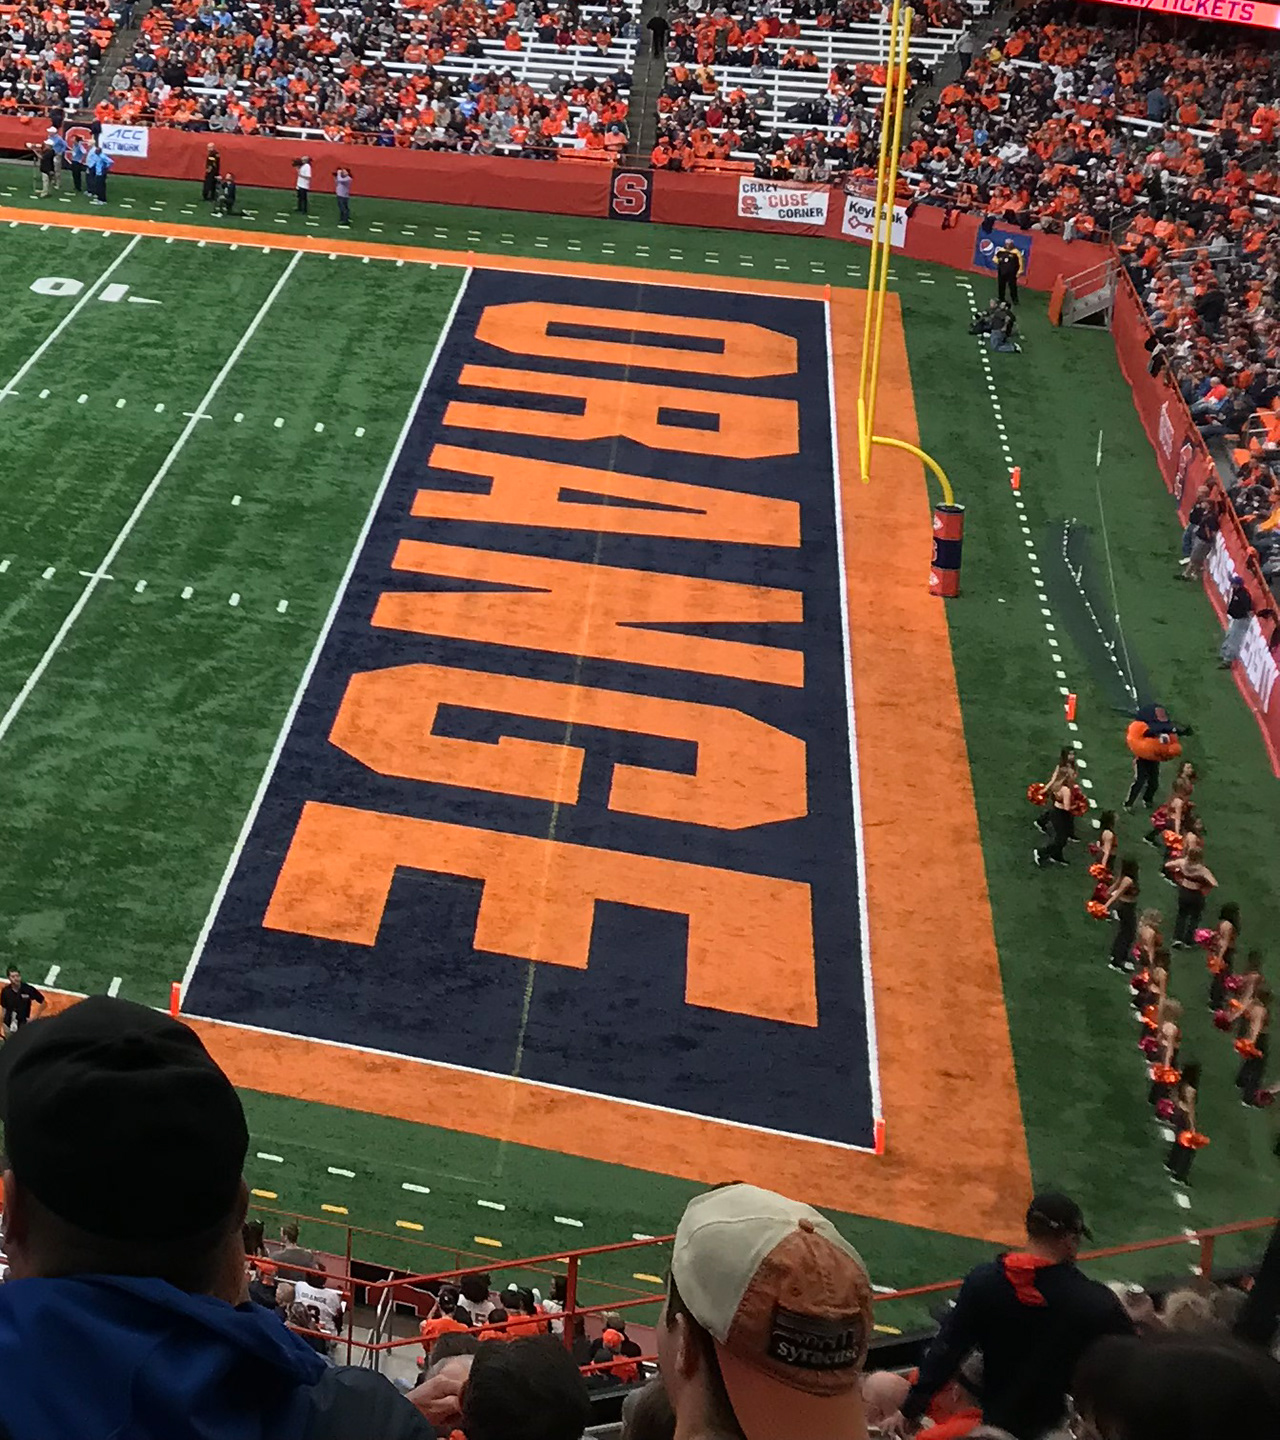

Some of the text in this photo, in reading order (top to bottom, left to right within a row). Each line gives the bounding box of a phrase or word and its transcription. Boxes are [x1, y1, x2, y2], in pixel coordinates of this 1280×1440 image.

[106, 129, 143, 141] ACC
[101, 141, 141, 153] NETWORK
[614, 172, 649, 217] S
[742, 183, 778, 194] CRAZY
[763, 193, 809, 208] 'CUSE
[778, 207, 824, 219] CORNER
[28, 275, 130, 303] 10
[261, 300, 819, 1028] ORANGE
[300, 1291, 328, 1305] ORANGE
